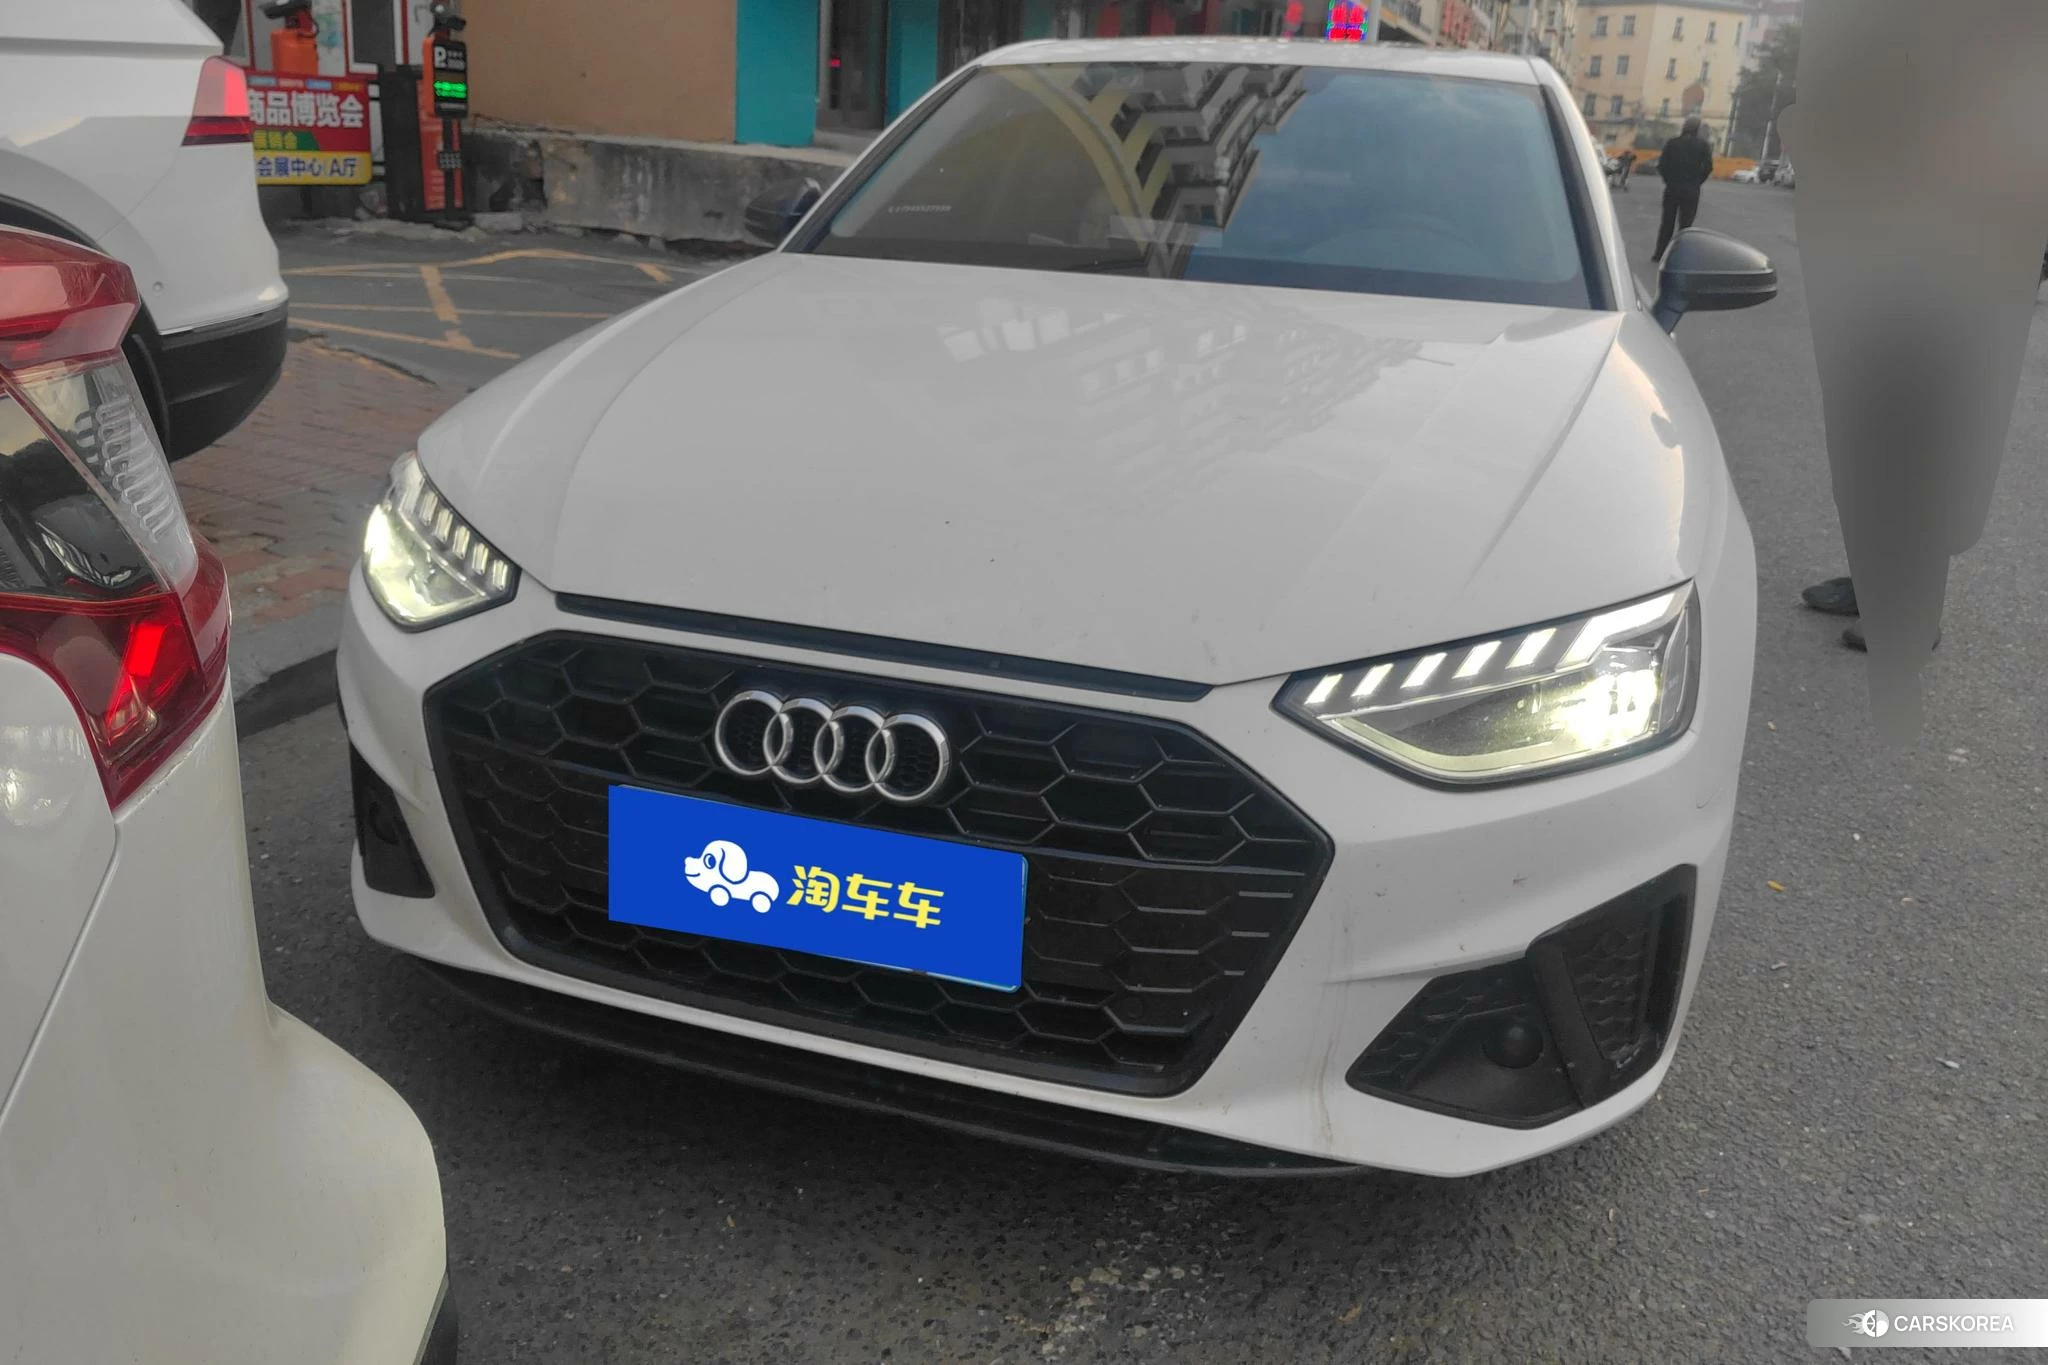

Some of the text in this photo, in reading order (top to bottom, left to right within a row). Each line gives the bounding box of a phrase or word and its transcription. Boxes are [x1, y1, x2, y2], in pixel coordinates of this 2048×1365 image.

[248, 89, 363, 127] 商品博览会
[256, 156, 357, 177] 会展中心 A厅
